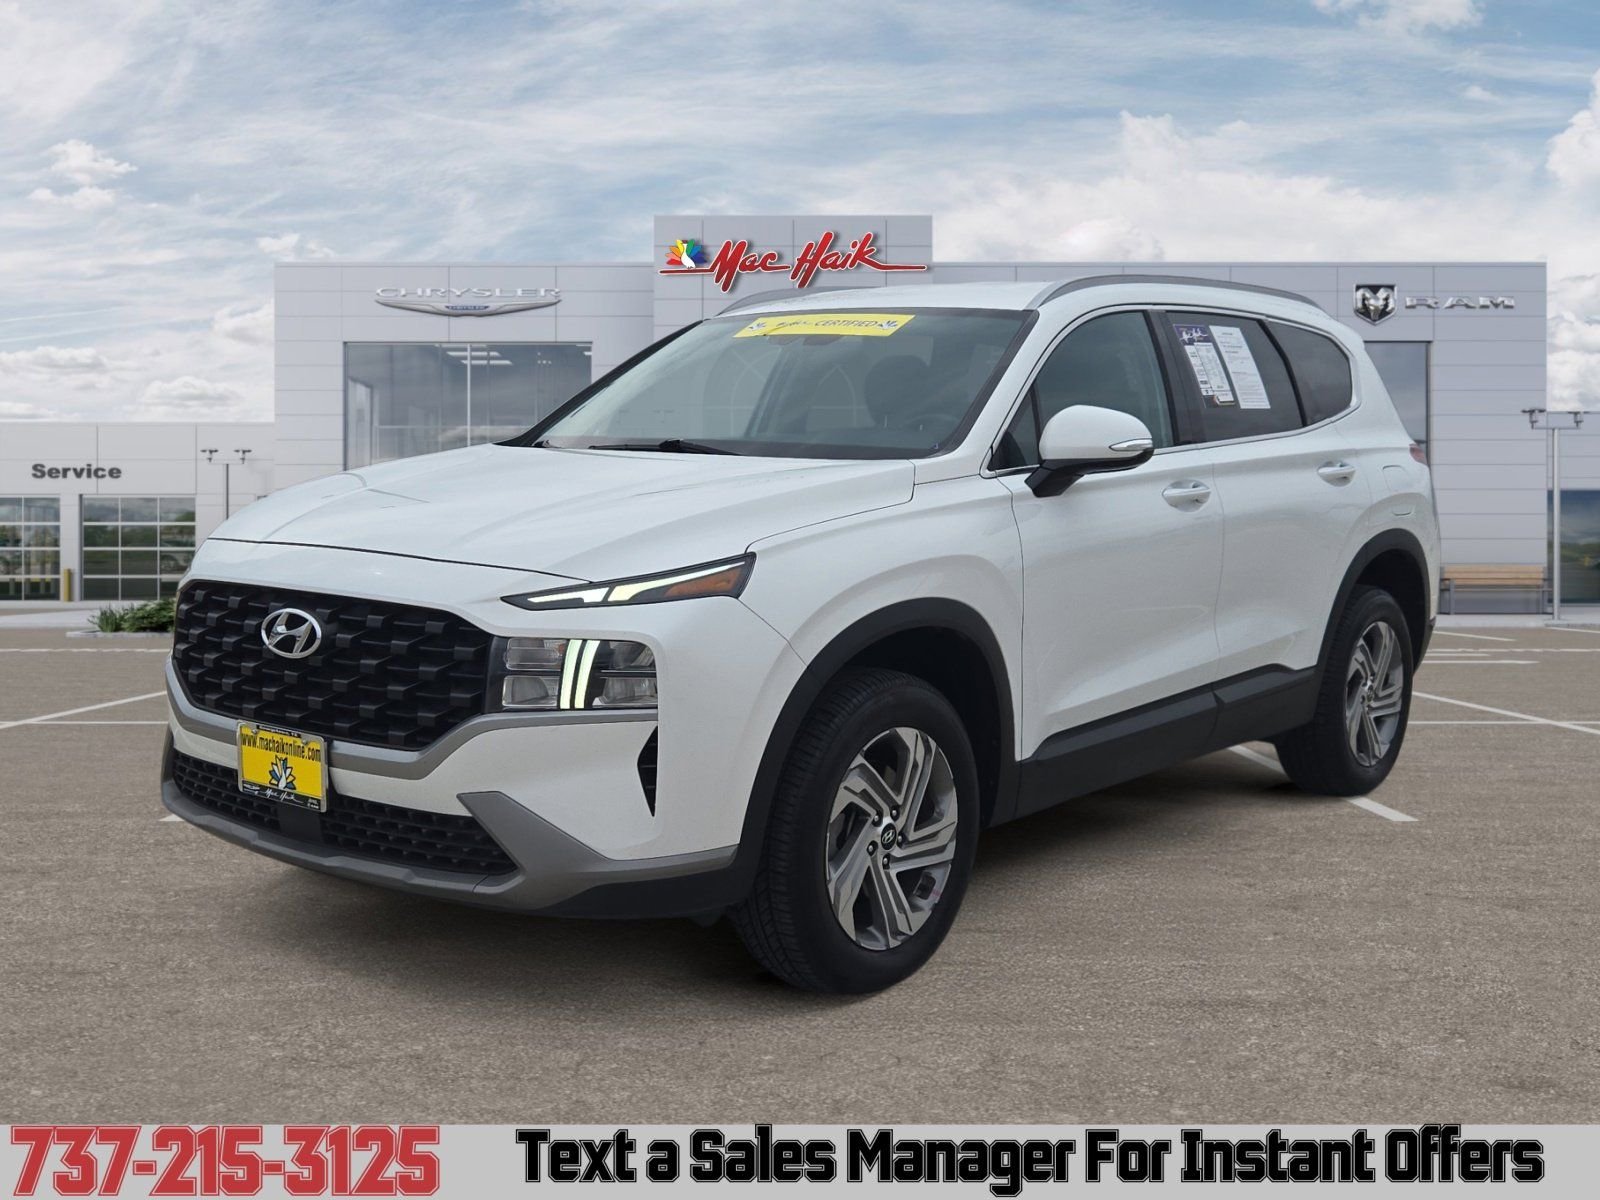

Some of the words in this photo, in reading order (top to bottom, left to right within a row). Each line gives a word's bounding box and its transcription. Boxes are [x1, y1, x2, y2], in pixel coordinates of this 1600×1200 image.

[704, 239, 792, 293] Mac
[789, 231, 927, 289] Haik
[375, 287, 562, 298] CHRYSLER
[1405, 296, 1516, 310] RAM
[815, 319, 878, 328] CERTIFIED
[31, 463, 122, 479] Service
